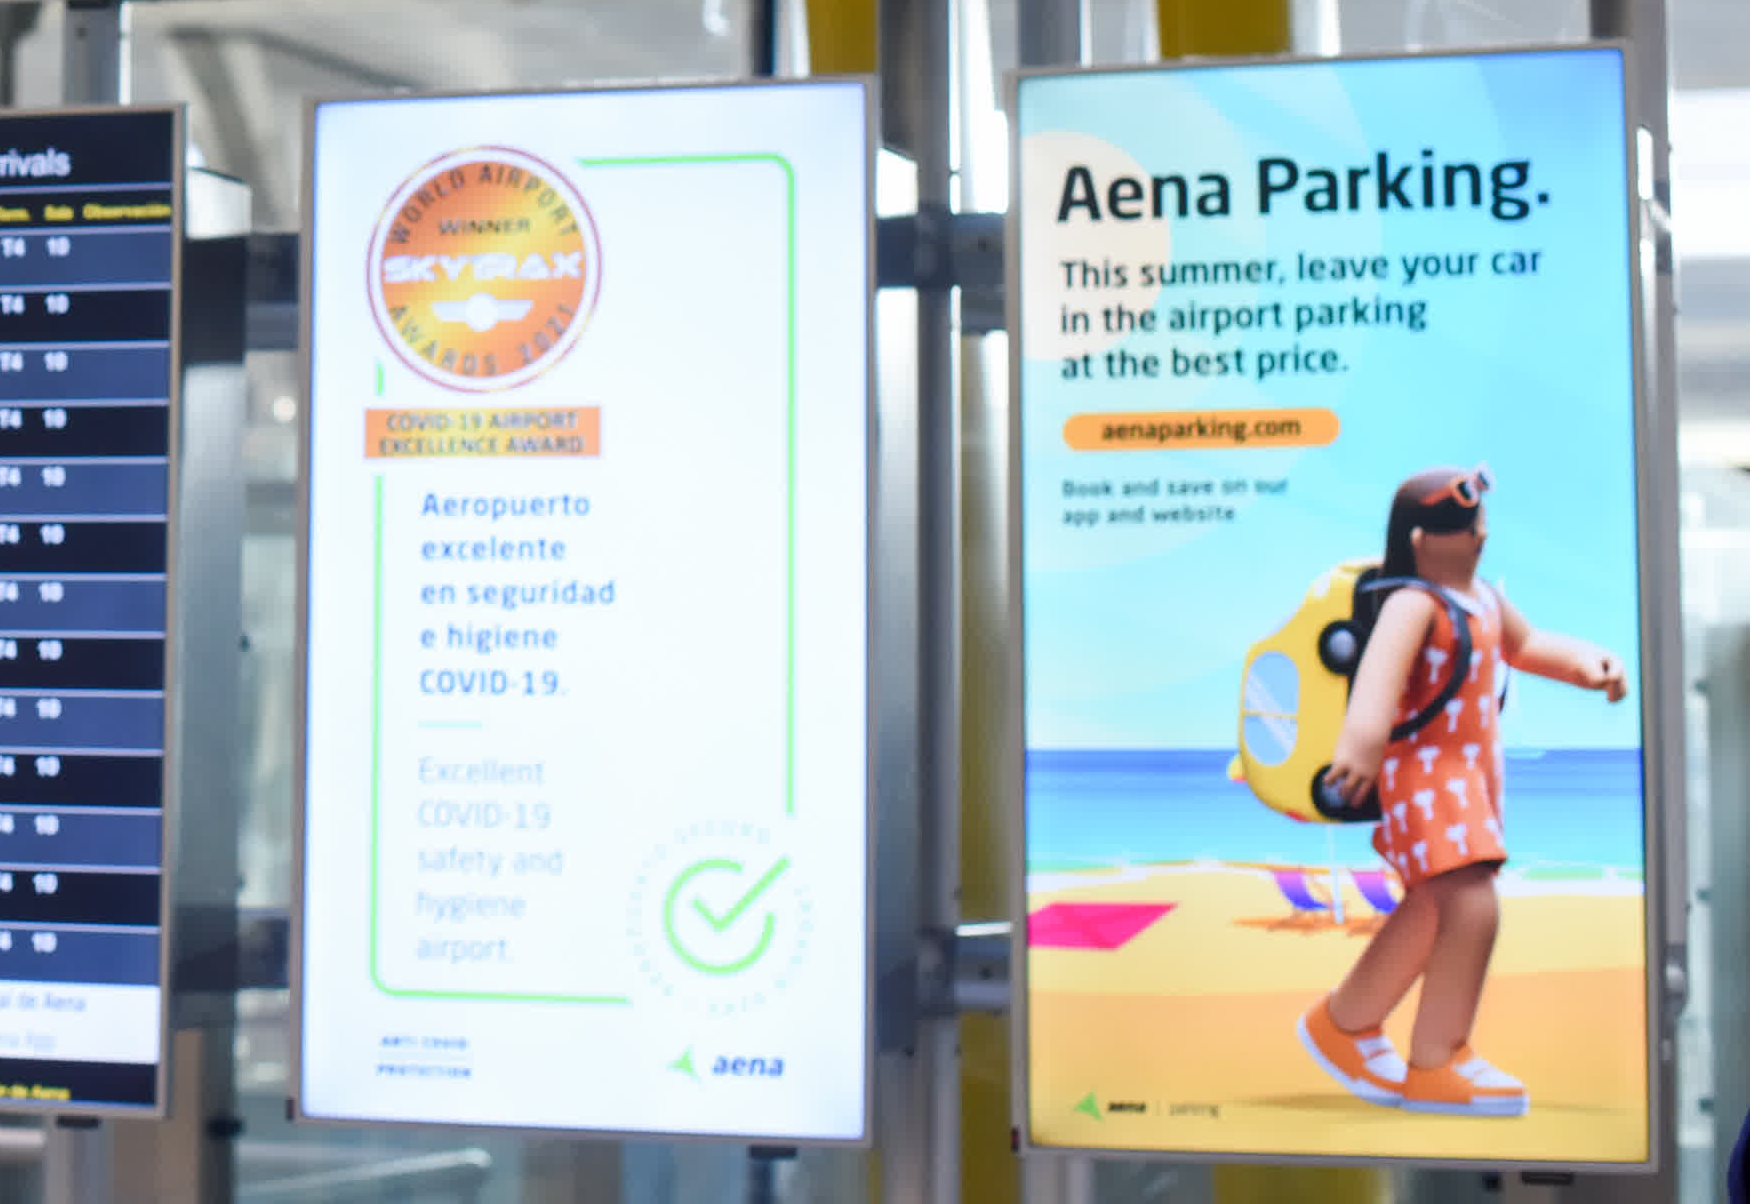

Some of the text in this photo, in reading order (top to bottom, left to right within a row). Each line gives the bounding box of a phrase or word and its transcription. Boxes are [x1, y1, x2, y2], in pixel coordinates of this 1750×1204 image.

[1057, 149, 1550, 223] Aena Parking.
[390, 164, 579, 245] WORLD AIRPORT
[437, 217, 530, 237] WINNER
[1060, 249, 1542, 288] This summer, leave your car
[1060, 297, 1427, 335] in the airport parking
[389, 302, 575, 376] AWARDS 2021
[1061, 346, 1349, 382] at the best price.
[387, 411, 578, 433] COVID-19 AIRPORT
[1101, 416, 1302, 446] aenaparking.com
[379, 434, 584, 456] EXCELLENCE AWARD
[1062, 477, 1289, 498] Book and save on our
[421, 493, 590, 521] Aeropuerto
[1061, 503, 1236, 526] app and website
[421, 539, 566, 561] excelente
[420, 580, 616, 610] en seguridad
[420, 625, 558, 654] e higiene
[418, 758, 545, 785] Excellent
[417, 801, 551, 829] COVID-19
[417, 847, 563, 879] safety and
[415, 892, 526, 922] hygiene
[712, 1053, 785, 1078] aena
[1109, 1100, 1146, 1114] aena
